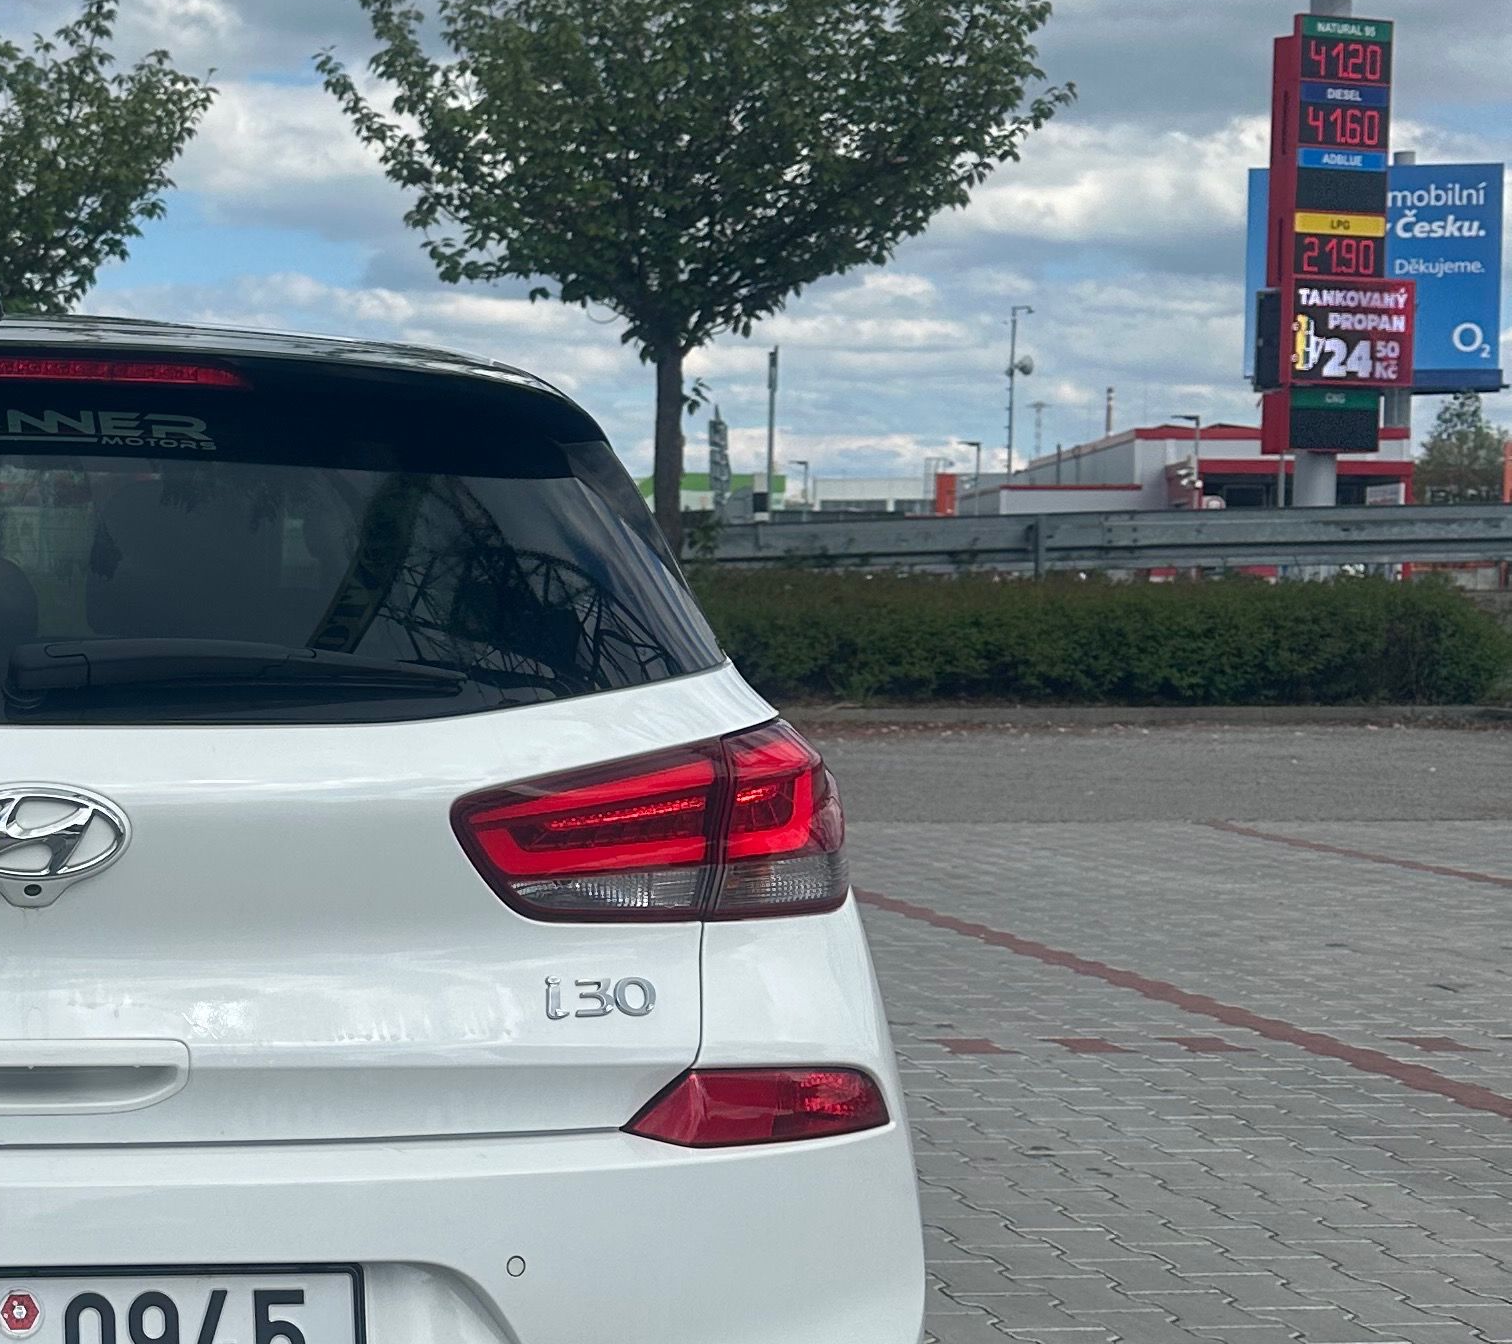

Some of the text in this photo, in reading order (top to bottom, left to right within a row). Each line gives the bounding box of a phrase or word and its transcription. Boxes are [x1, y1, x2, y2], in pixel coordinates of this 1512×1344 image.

[1317, 22, 1377, 38] NATURAL 95
[1310, 40, 1382, 80] 41.20
[1326, 88, 1362, 102] DIESEL
[1307, 106, 1380, 145] 41.60
[1388, 182, 1487, 207] mobilní
[1330, 219, 1350, 230] LPG
[1395, 209, 1486, 239] Česku.
[1394, 257, 1485, 277] Děkujeme.
[1298, 287, 1409, 309] TANKOVANÝ
[1328, 313, 1406, 332] PROPAN
[1322, 338, 1373, 378] 24
[1376, 341, 1400, 358] 50
[1374, 360, 1398, 380] Kč
[100, 436, 217, 452] MOTORS
[545, 975, 656, 1020] i30
